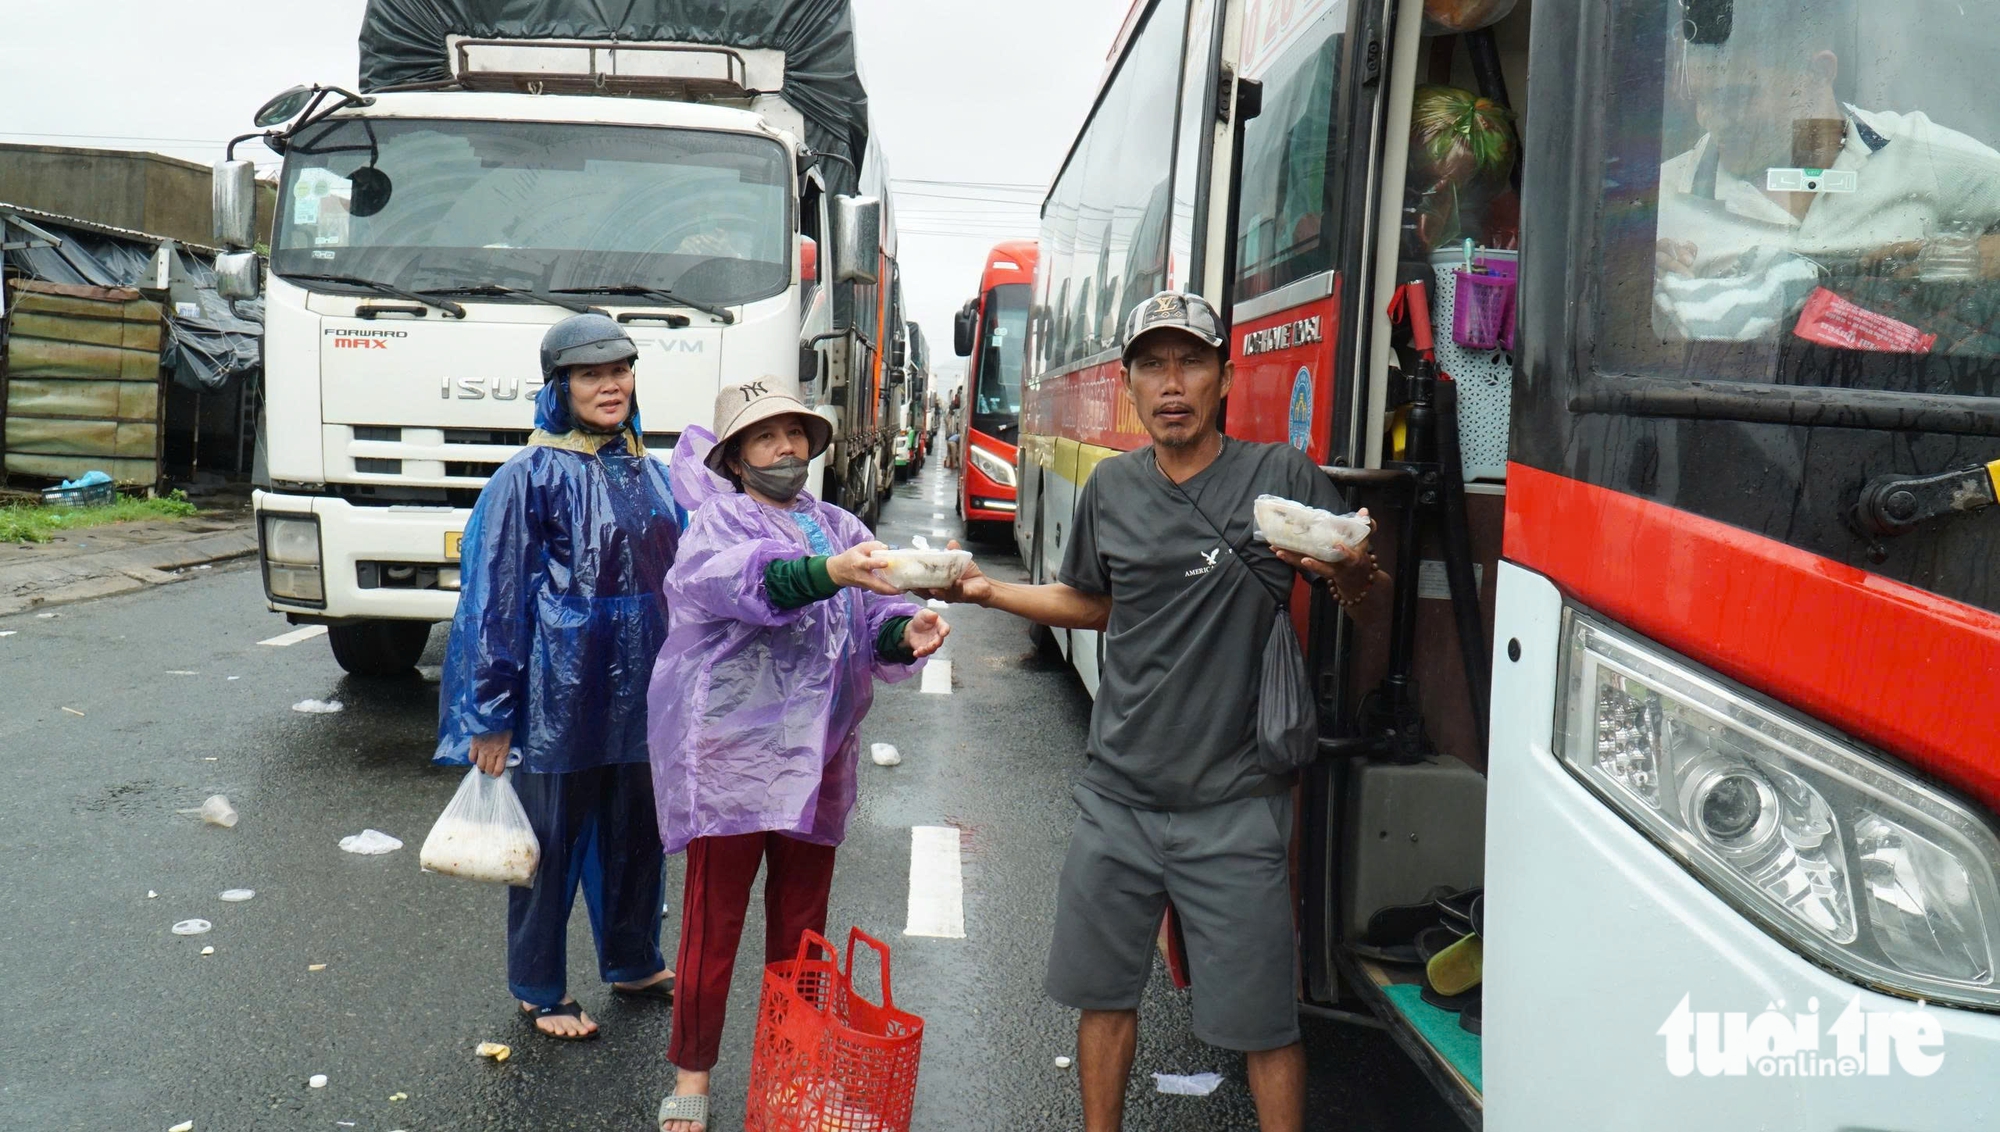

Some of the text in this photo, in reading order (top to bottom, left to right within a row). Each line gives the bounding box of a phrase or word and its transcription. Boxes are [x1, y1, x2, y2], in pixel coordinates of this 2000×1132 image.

[324, 328, 408, 338] FORWARD
[334, 338, 388, 349] MAX
[441, 375, 544, 401] ISUZ
[739, 381, 768, 402] NY
[1184, 565, 1214, 577] AMERIC
